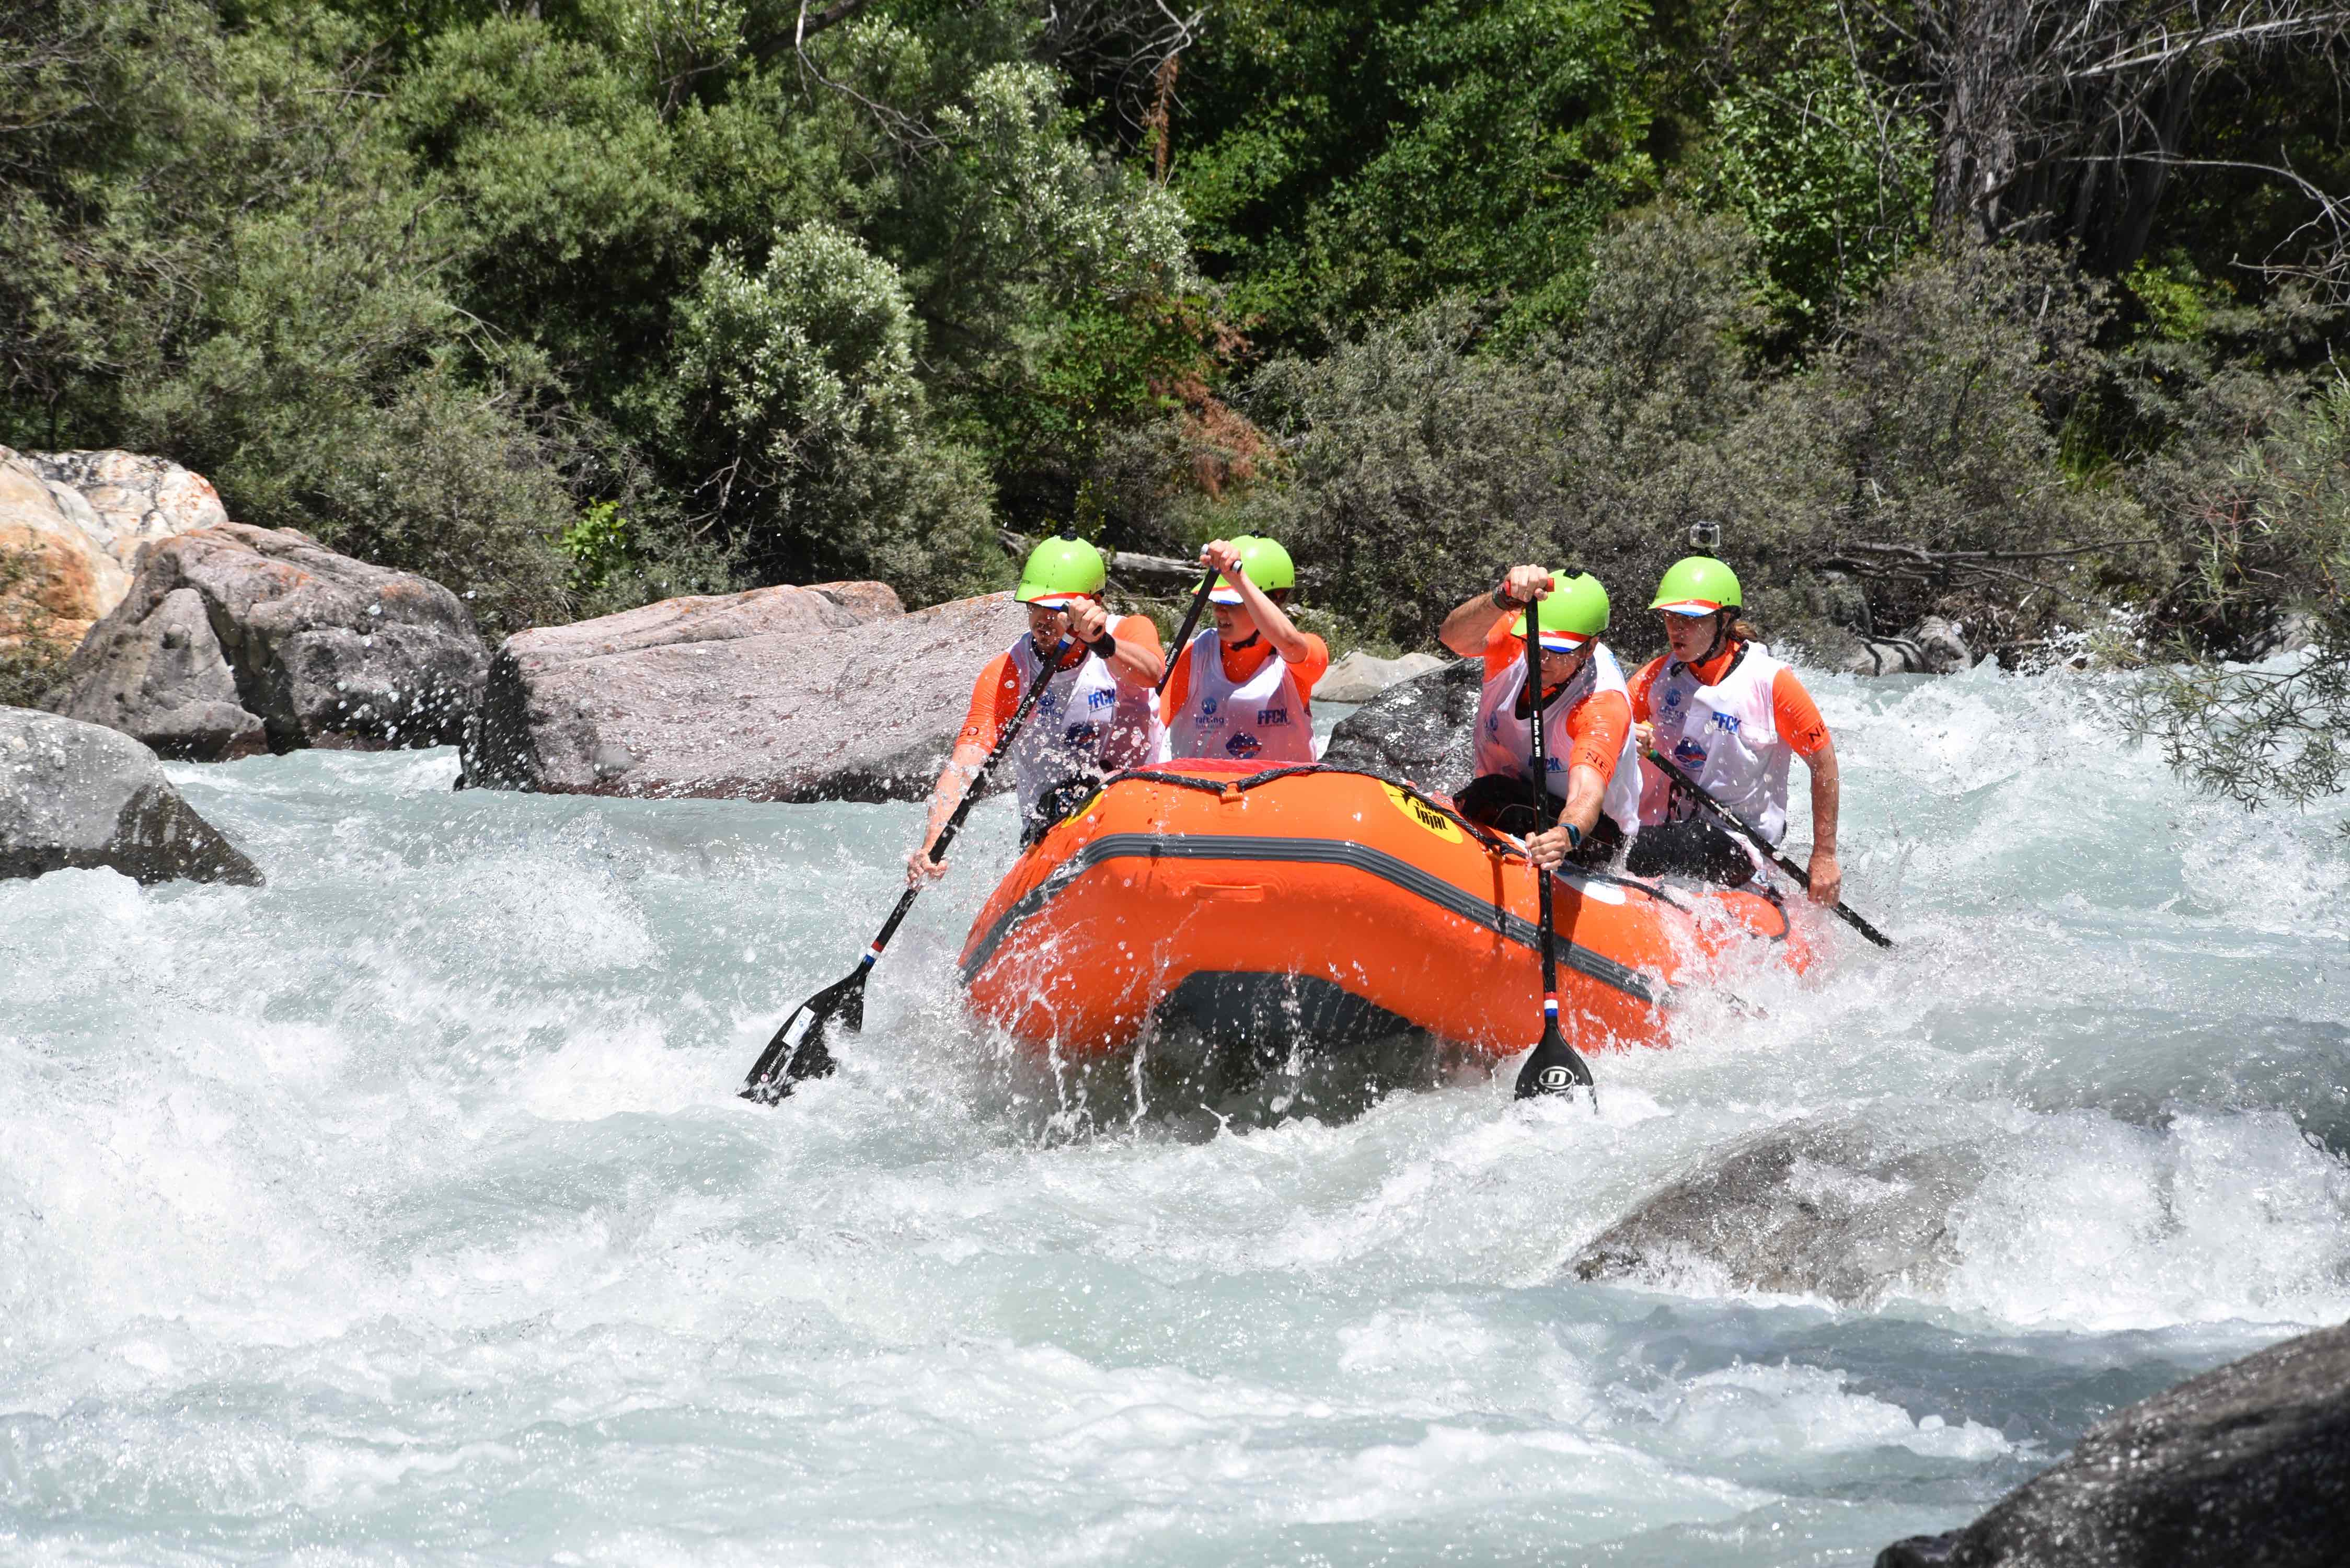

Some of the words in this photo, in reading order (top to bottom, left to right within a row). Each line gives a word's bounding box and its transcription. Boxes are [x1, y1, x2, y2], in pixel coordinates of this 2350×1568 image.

[1088, 689, 1115, 708] FFCK
[1257, 708, 1288, 725] FFCK
[1545, 1070, 1567, 1086] D
